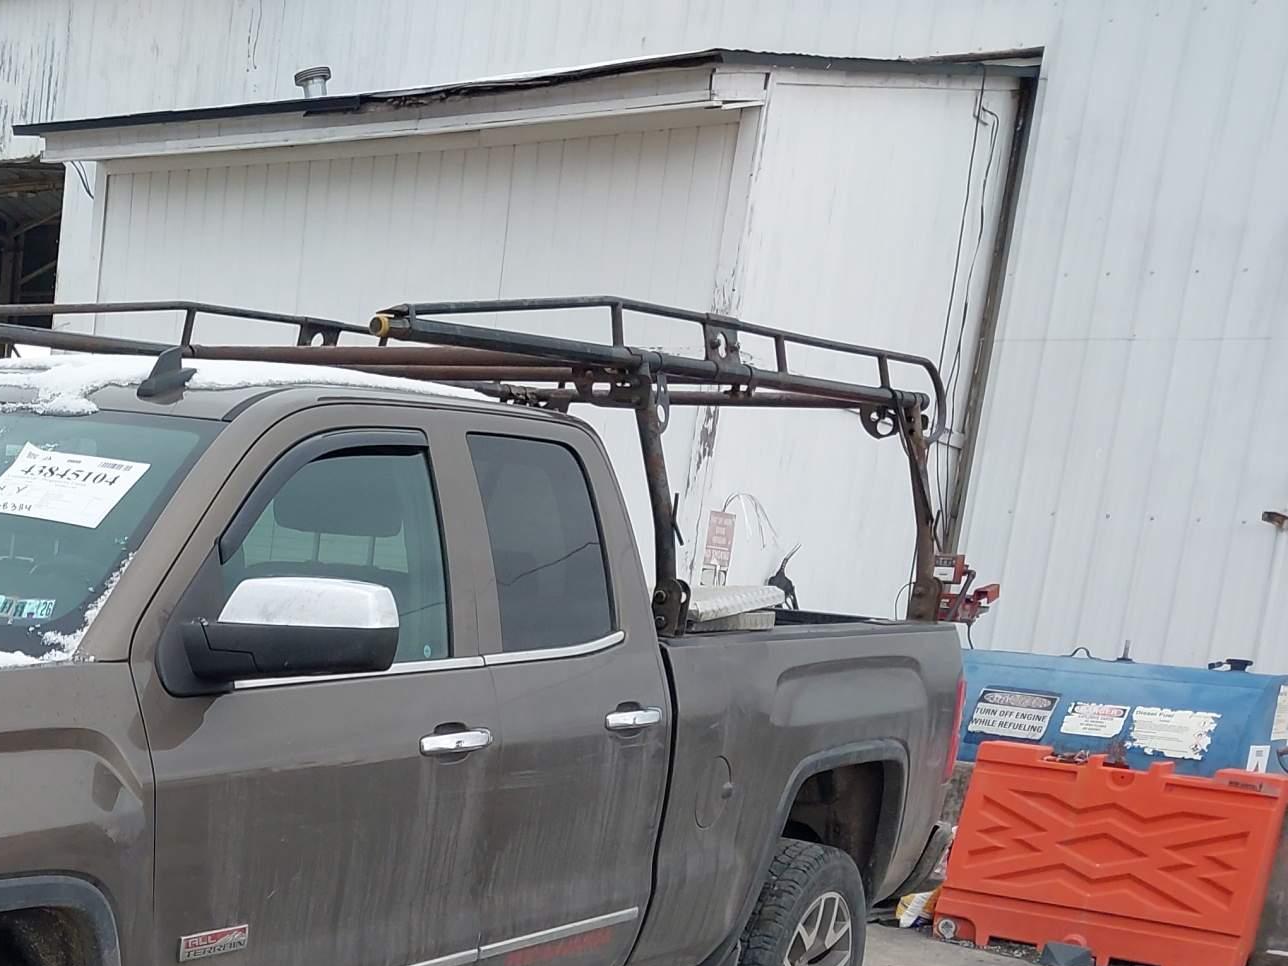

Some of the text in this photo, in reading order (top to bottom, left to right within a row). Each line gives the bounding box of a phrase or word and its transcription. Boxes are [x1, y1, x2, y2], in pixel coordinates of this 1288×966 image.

[21, 464, 120, 486] 43845104
[39, 601, 53, 617] 26
[975, 706, 1048, 722] TURN OFF ENGINE
[972, 718, 1043, 733] WHILE REFUELING
[188, 934, 217, 947] ALL
[186, 940, 246, 958] TERRAIN
